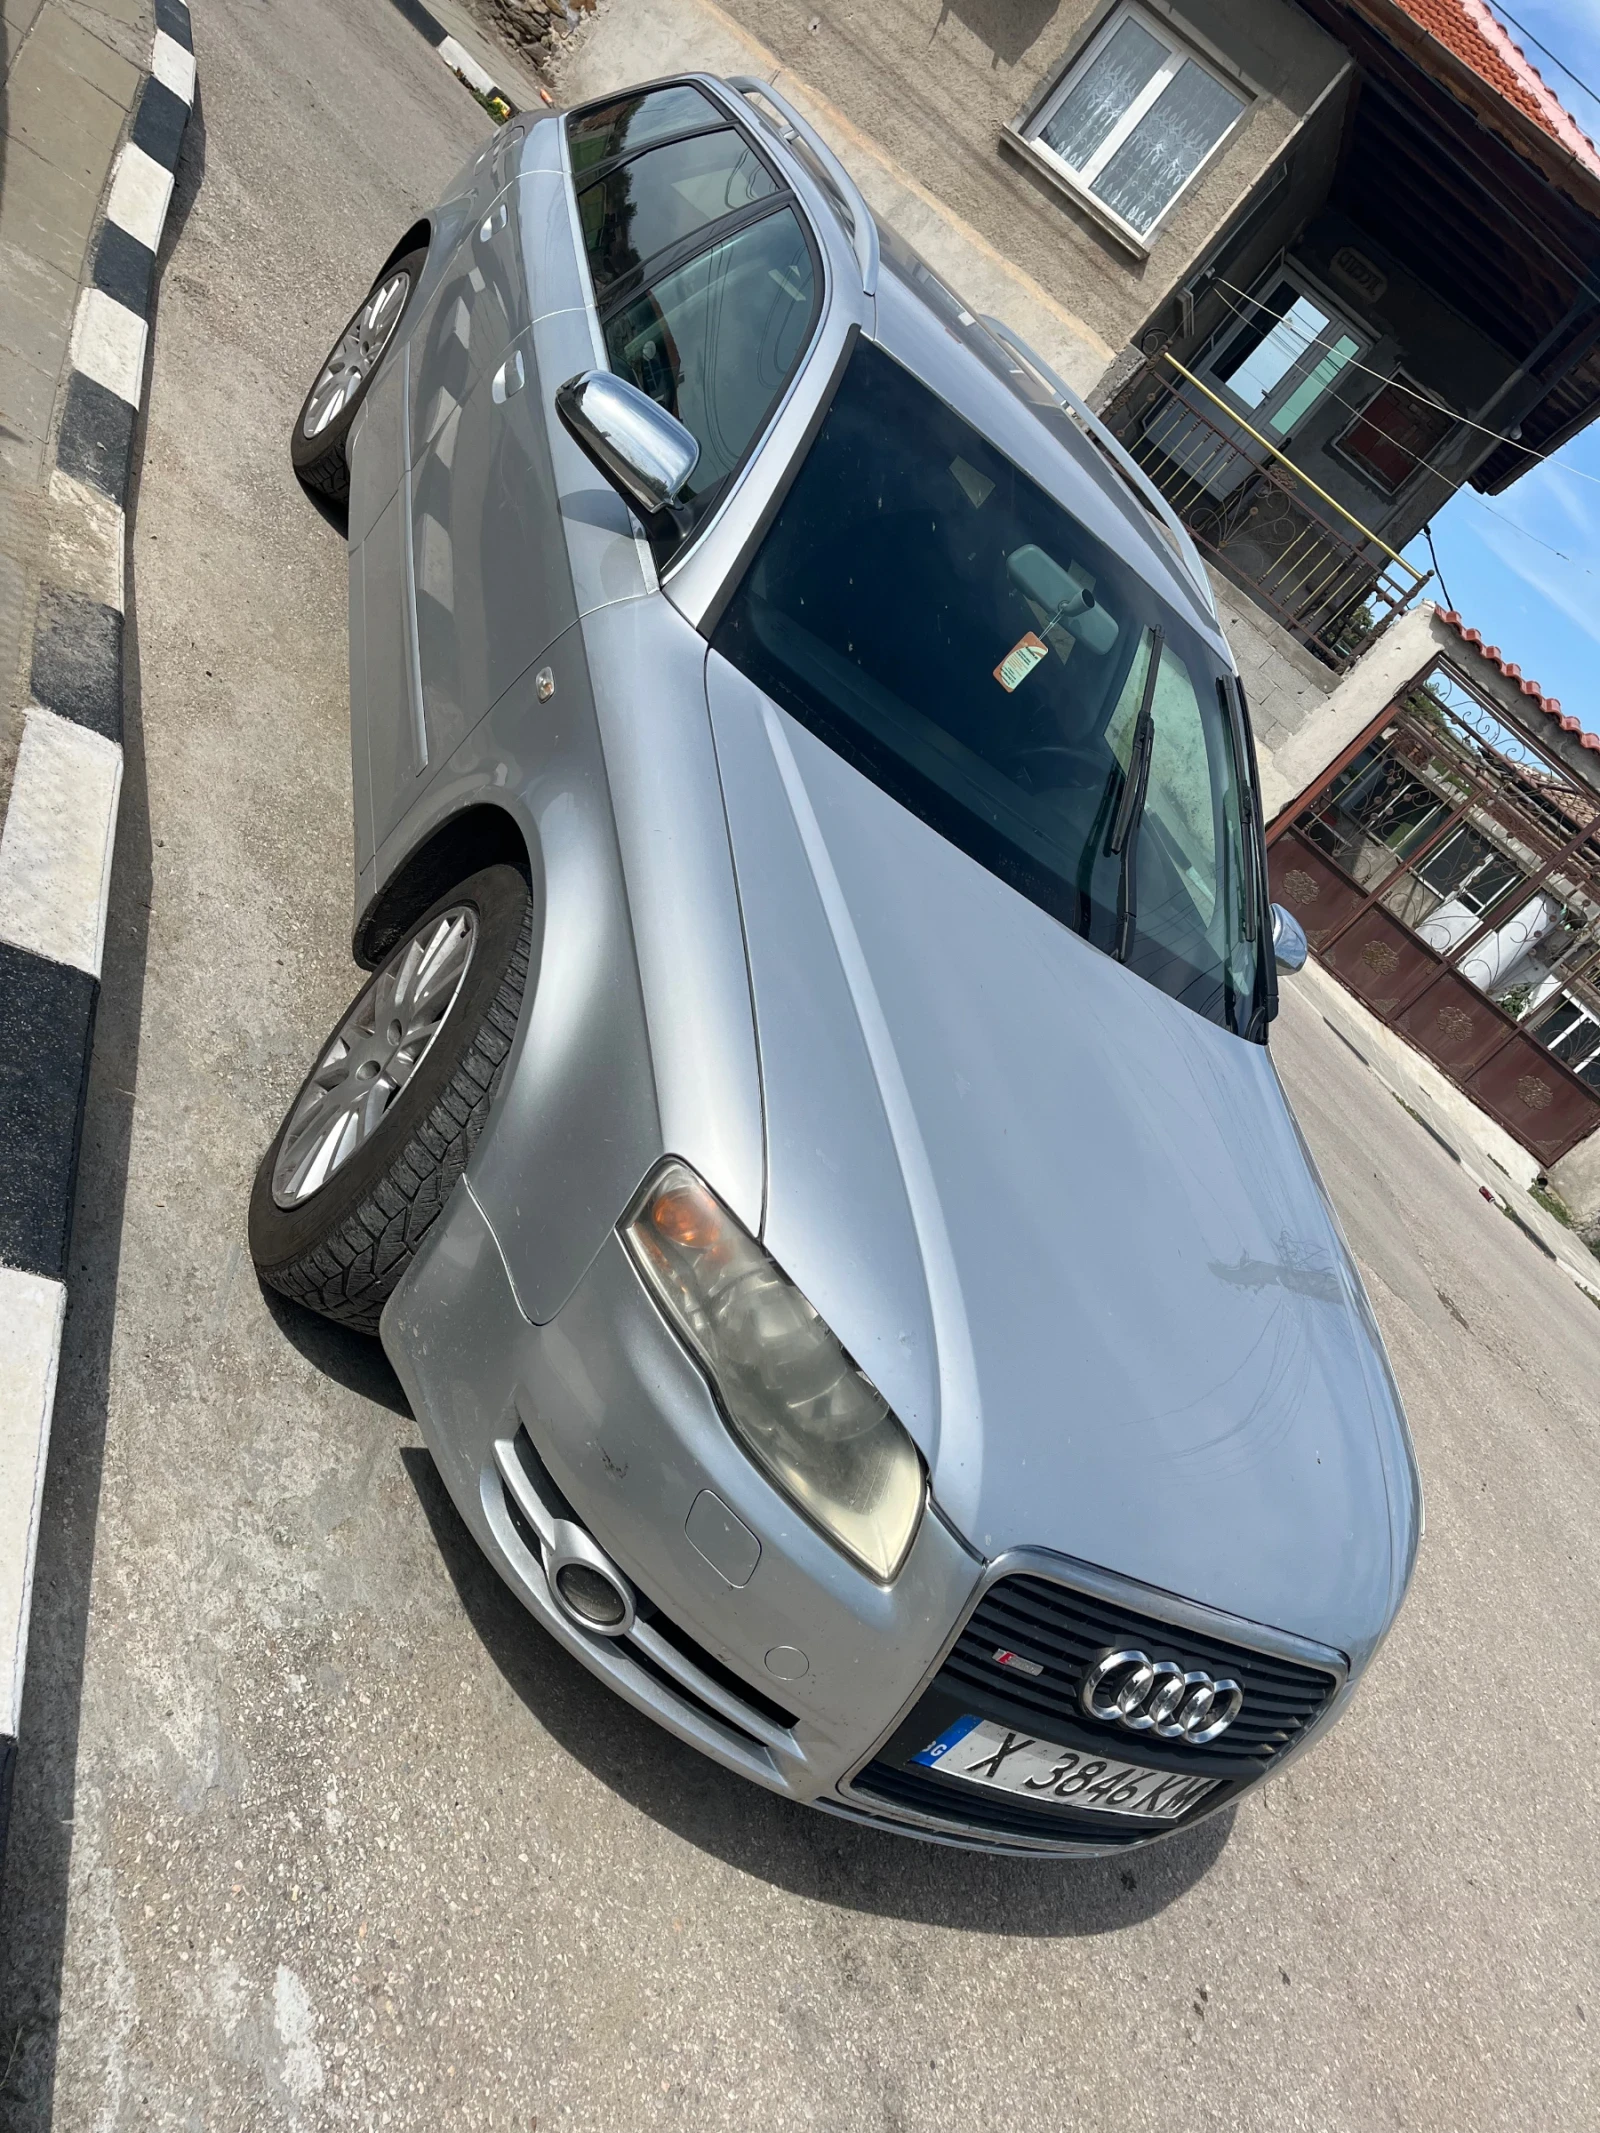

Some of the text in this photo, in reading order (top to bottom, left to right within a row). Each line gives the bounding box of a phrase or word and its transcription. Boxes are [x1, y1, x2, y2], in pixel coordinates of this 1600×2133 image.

[964, 1732, 1216, 1813] X 3846 KM
